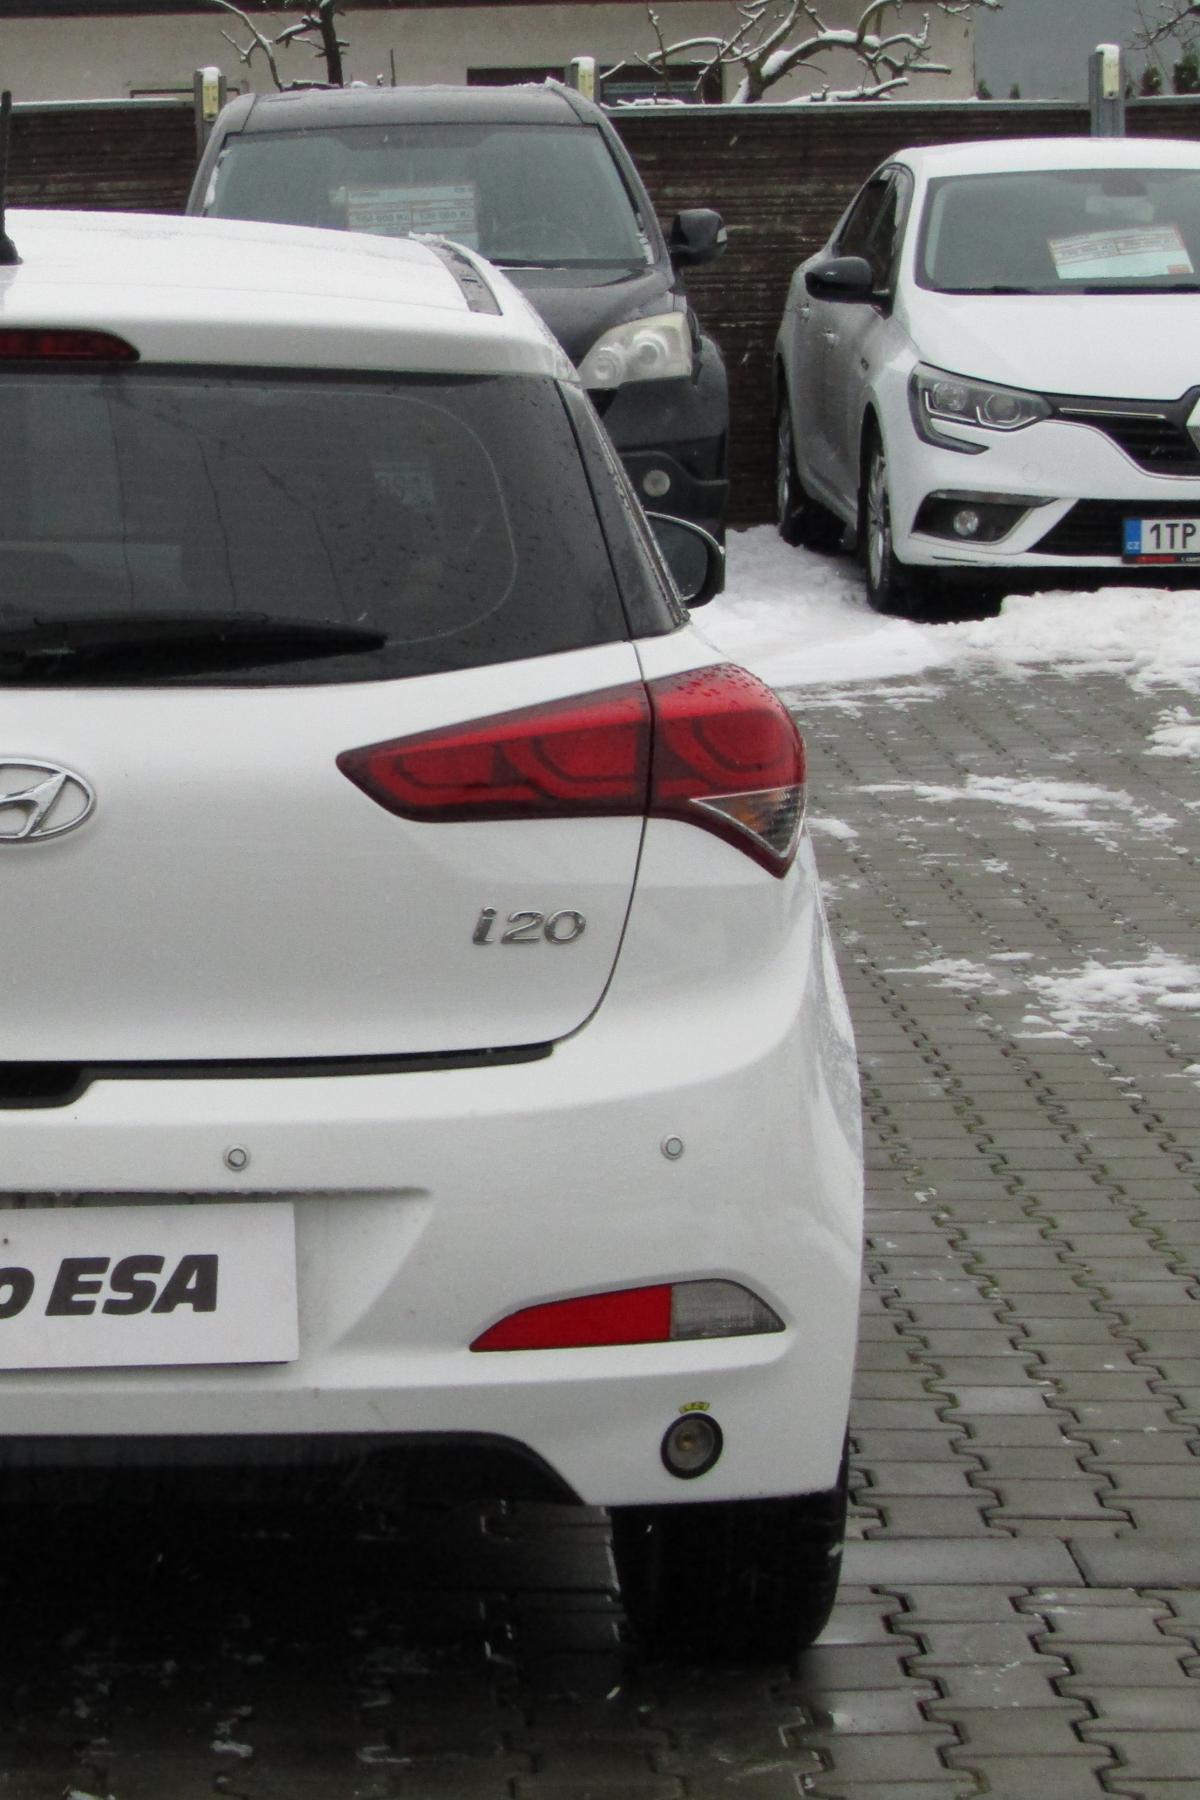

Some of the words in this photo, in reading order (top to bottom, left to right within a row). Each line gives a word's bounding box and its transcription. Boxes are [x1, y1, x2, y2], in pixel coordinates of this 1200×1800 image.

[1150, 523, 1197, 549] 1TP
[472, 906, 587, 945] i20
[44, 1254, 219, 1317] ESA
